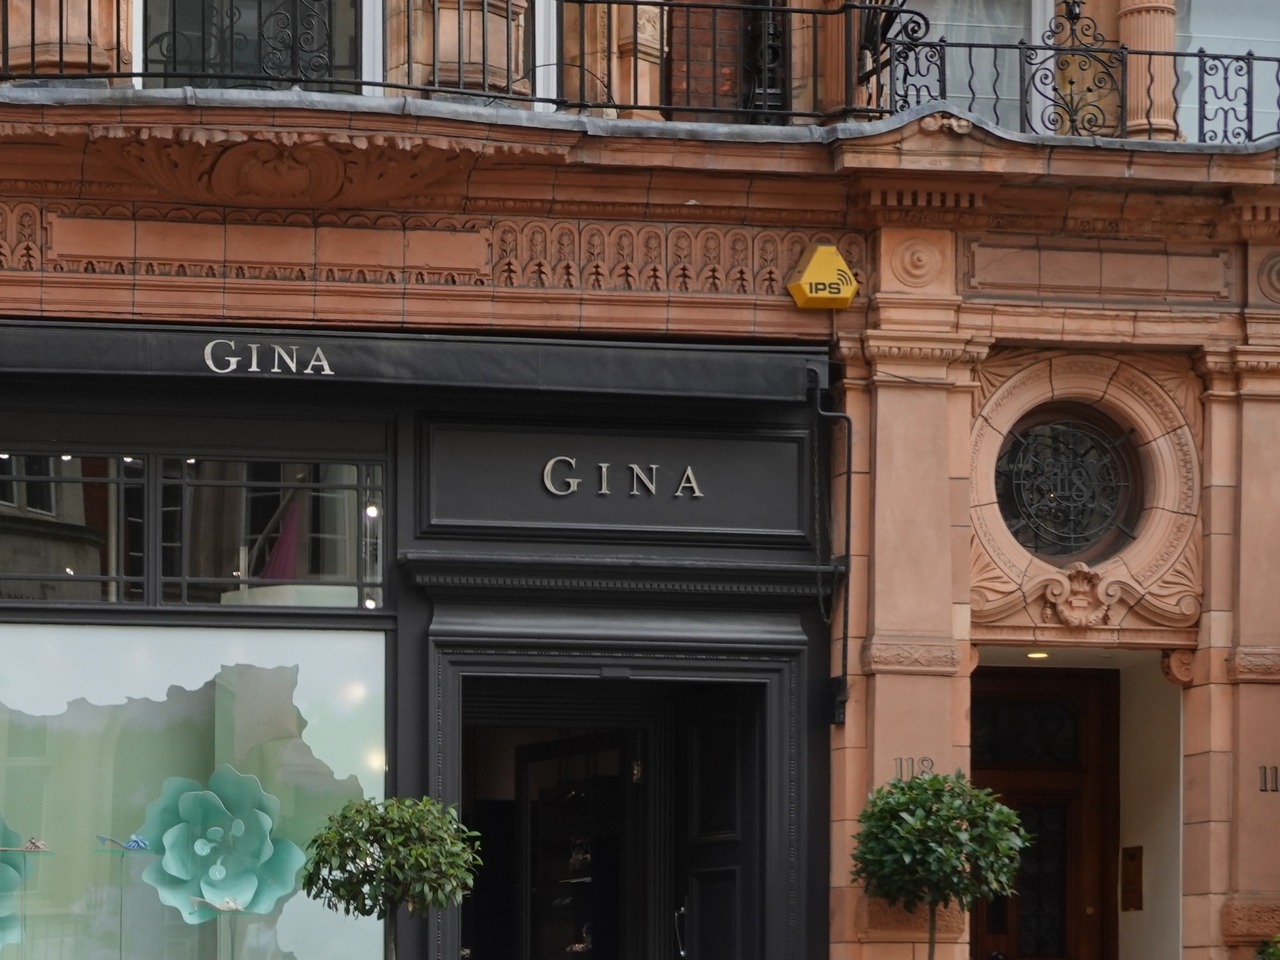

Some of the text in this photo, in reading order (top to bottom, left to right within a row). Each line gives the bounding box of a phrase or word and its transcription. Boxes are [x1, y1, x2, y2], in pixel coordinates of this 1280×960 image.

[809, 282, 841, 294] IPS
[203, 339, 335, 375] GINA
[543, 456, 705, 498] GINA
[893, 756, 934, 782] 118
